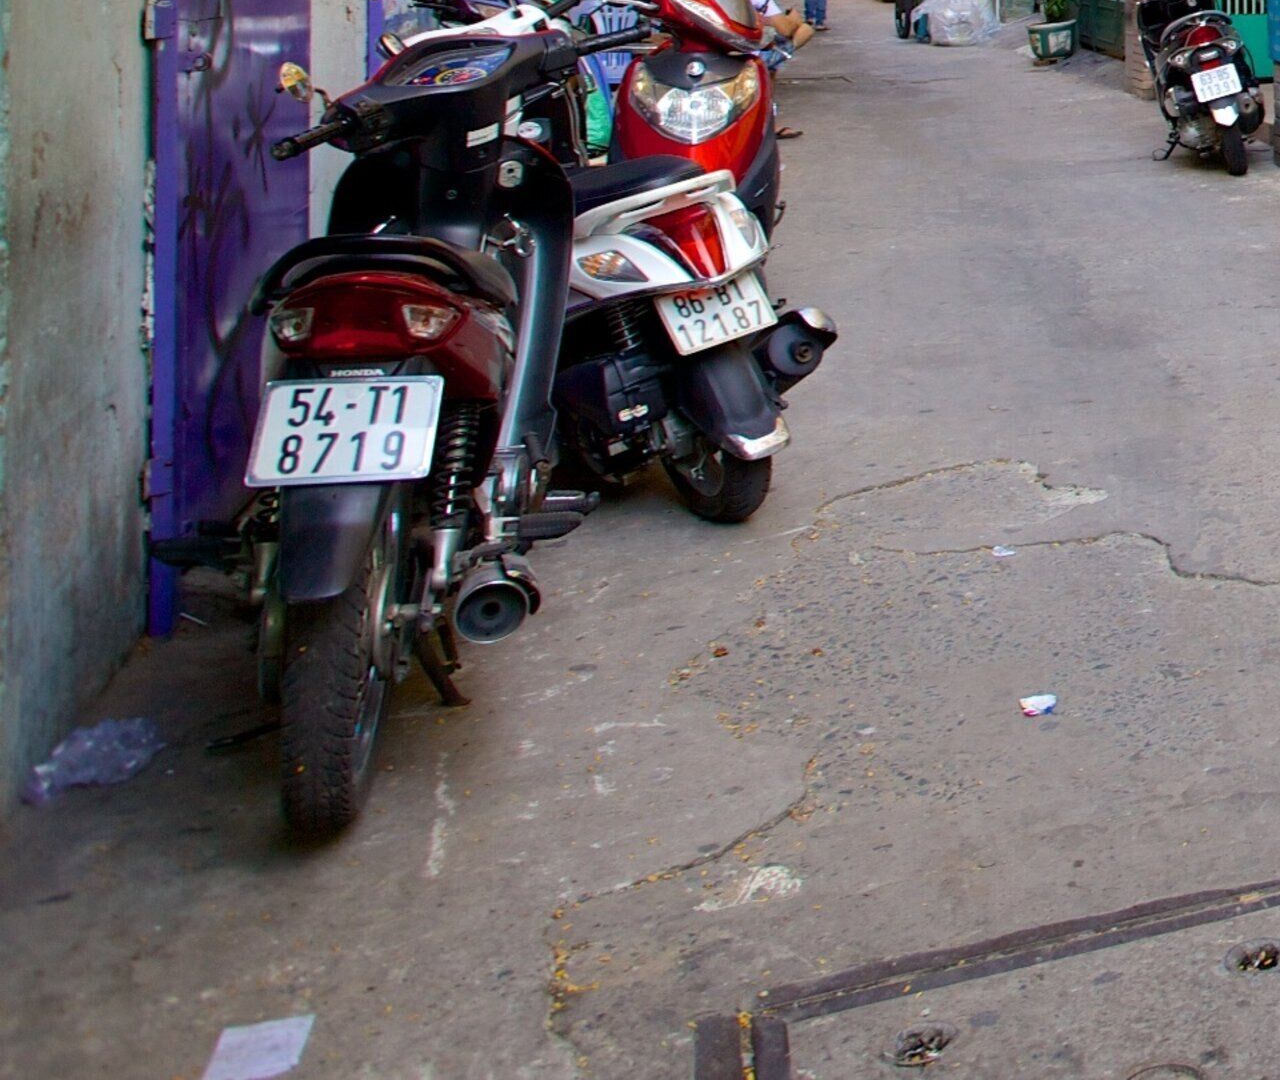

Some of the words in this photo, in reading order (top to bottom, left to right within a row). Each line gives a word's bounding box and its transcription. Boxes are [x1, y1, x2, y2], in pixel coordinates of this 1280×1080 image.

[677, 299, 763, 348] 121.87
[330, 368, 385, 378] HONDA
[287, 384, 409, 428] 54-T1
[276, 430, 406, 475] 8719
